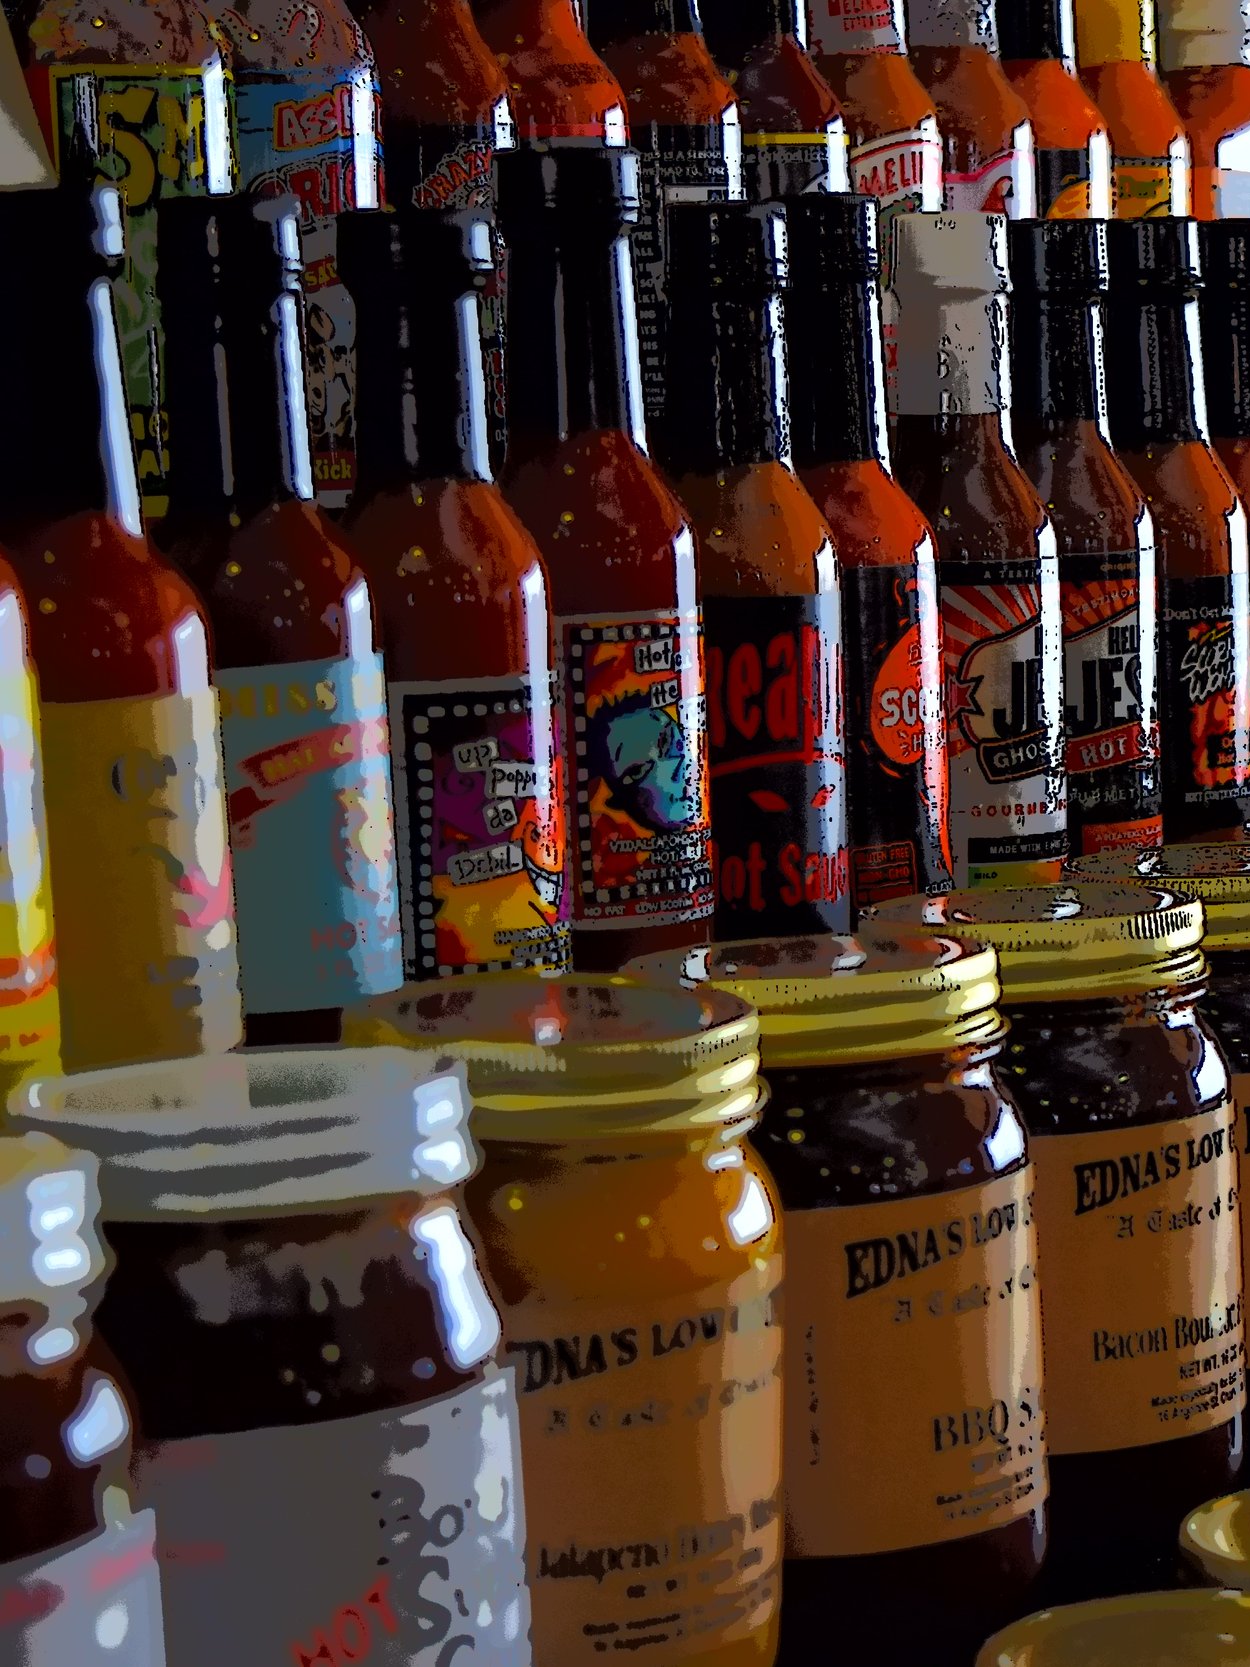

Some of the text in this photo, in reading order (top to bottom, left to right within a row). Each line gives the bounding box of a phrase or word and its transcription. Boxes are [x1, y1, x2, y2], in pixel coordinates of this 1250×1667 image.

[989, 845, 1018, 855] MADE
[1073, 1143, 1182, 1217] EDNA'S
[844, 1220, 966, 1299] EDNA'S
[1093, 1325, 1169, 1362] Bacon
[931, 1398, 1010, 1453] BBQ
